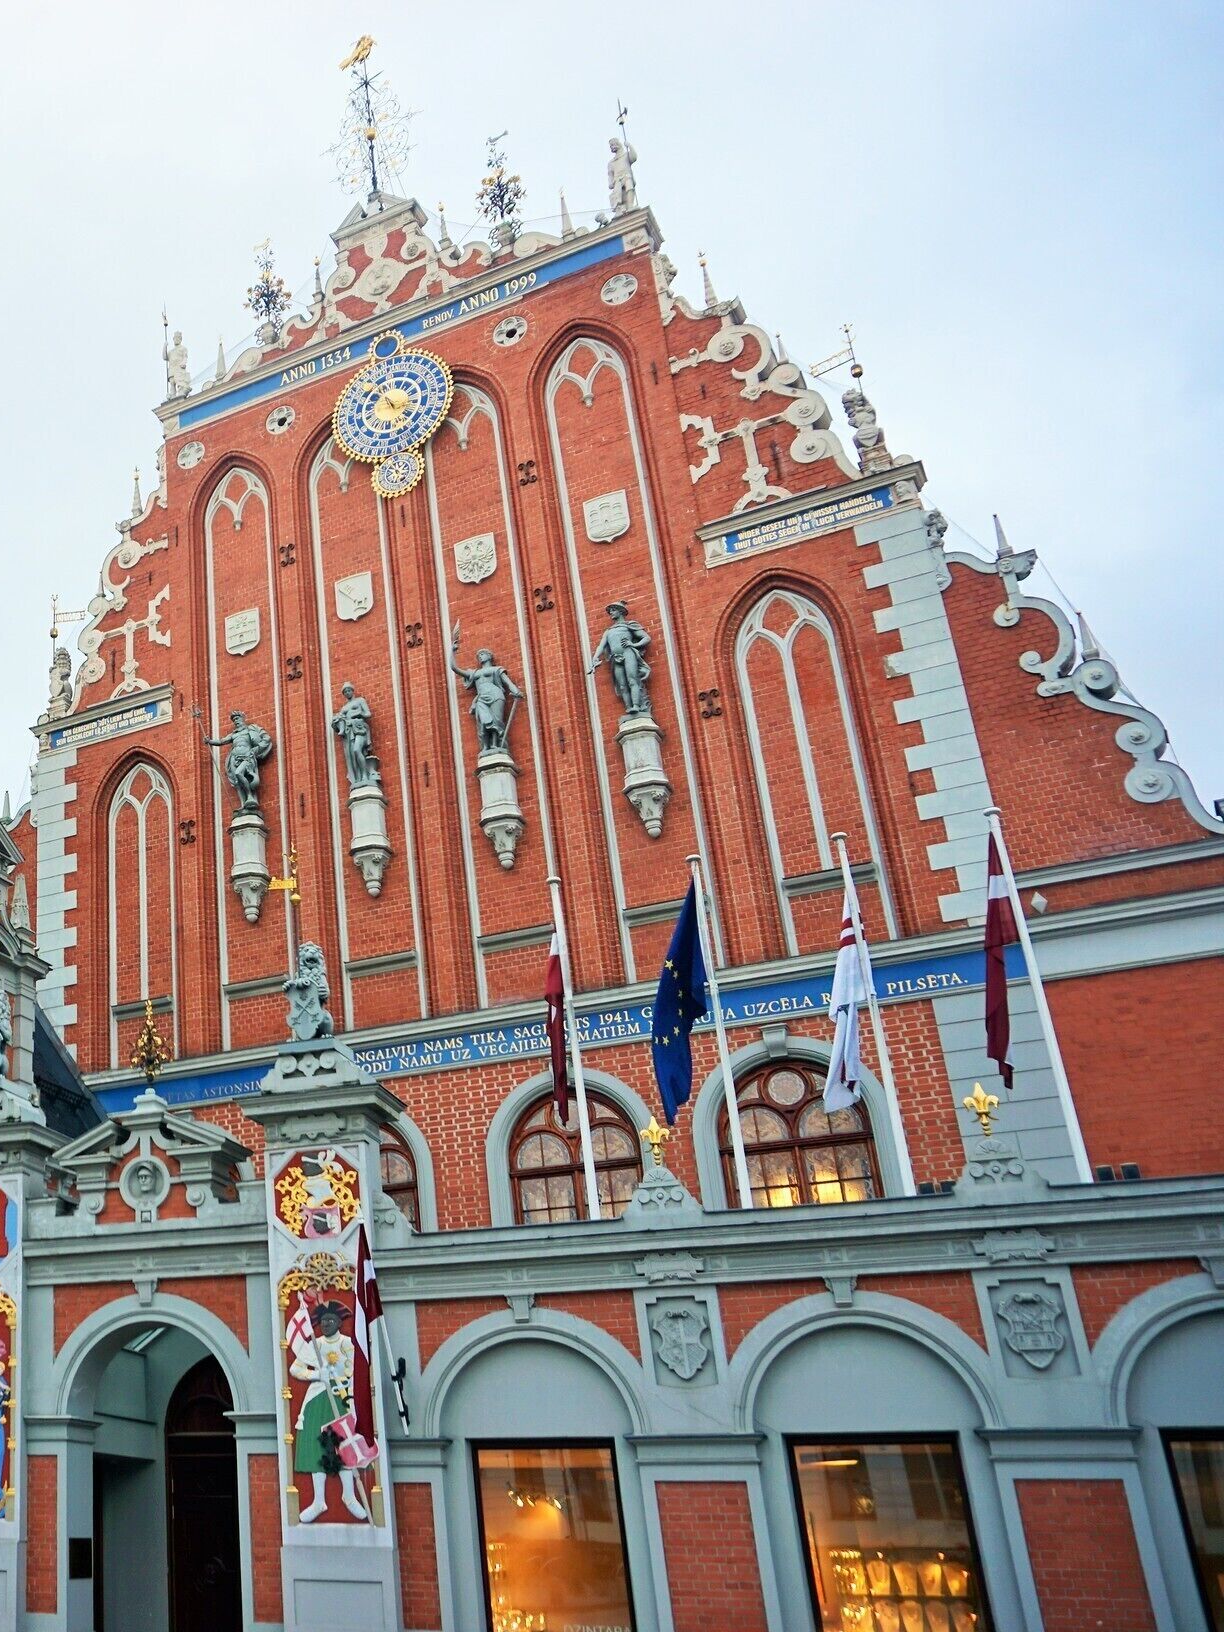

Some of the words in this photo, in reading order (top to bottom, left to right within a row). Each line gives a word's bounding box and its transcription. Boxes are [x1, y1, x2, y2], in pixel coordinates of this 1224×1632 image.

[458, 287, 499, 315] ANNO
[505, 272, 537, 296] 1999
[280, 361, 316, 386] ANNO
[321, 347, 350, 370] 1334
[354, 1043, 416, 1063] NGALVJU
[423, 1036, 464, 1053] NAMS
[470, 1030, 506, 1046] TIKA
[600, 1010, 634, 1025] 1941.
[358, 1060, 392, 1074] ODU
[399, 1052, 443, 1070] NAMU
[451, 1048, 471, 1062] UZ
[478, 1035, 552, 1057] VECAJIEM
